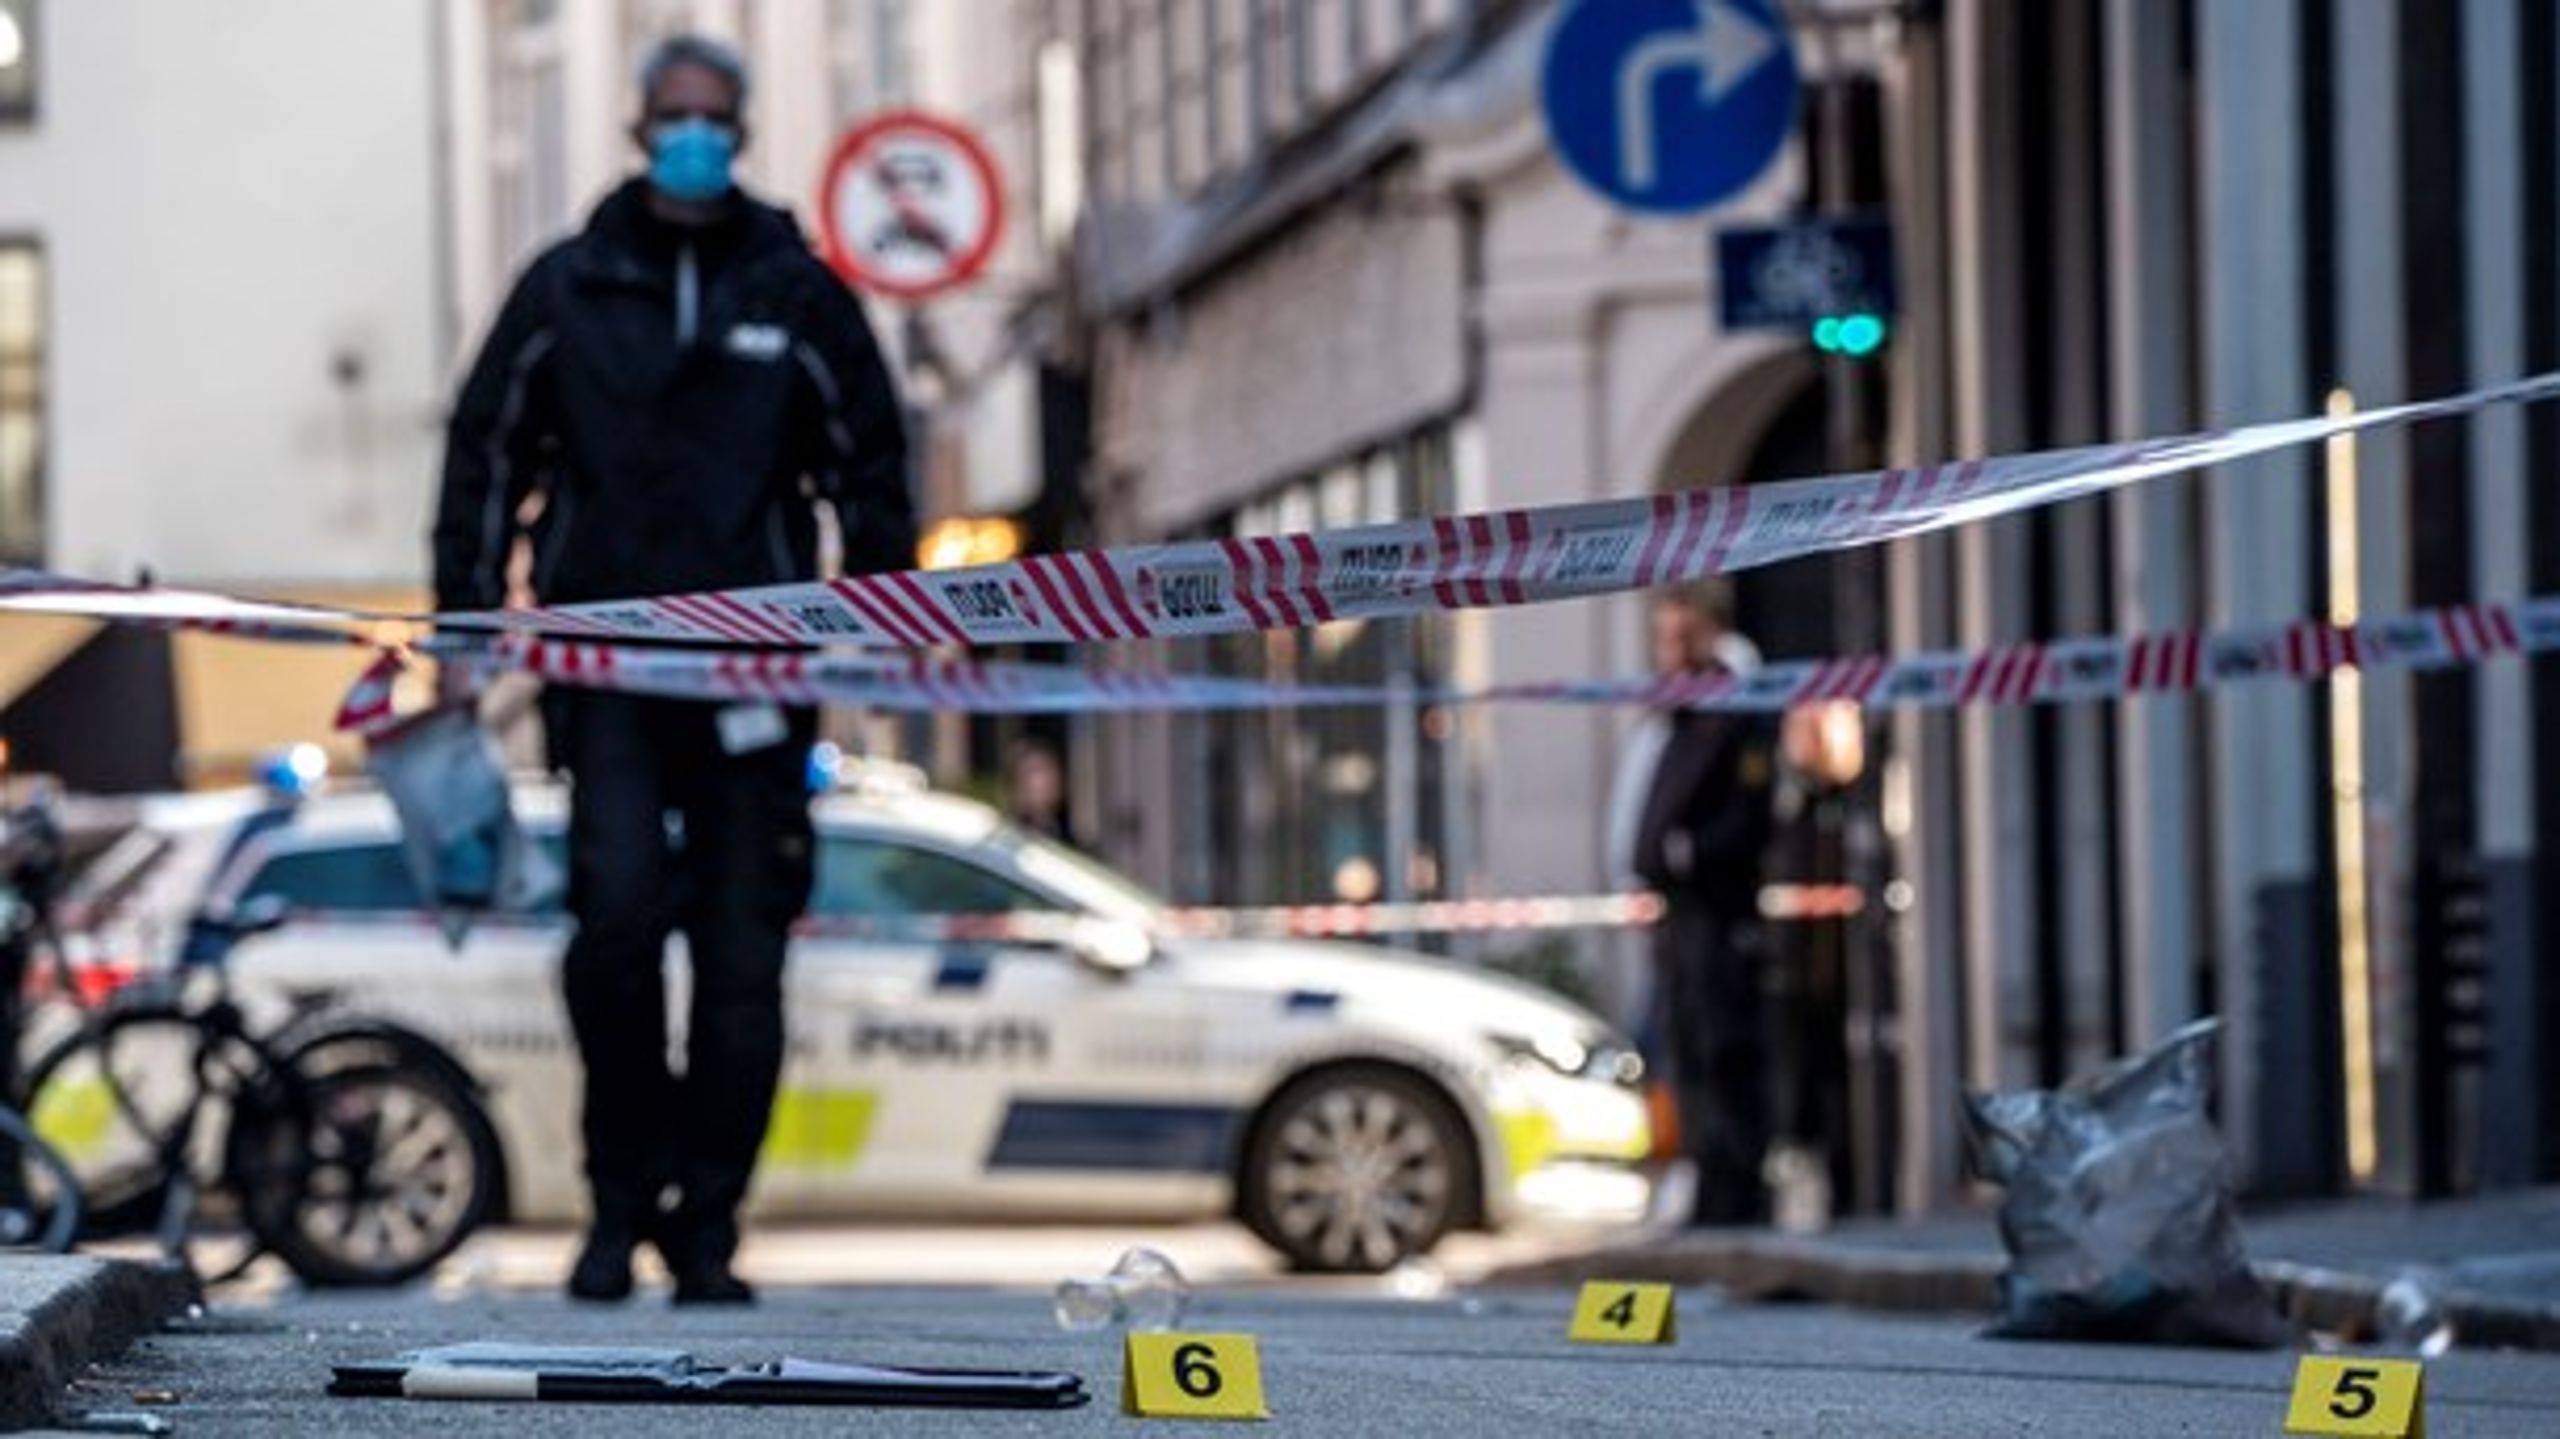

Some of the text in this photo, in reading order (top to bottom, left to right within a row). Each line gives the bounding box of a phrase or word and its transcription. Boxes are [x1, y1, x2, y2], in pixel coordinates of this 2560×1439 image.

[852, 1022, 1053, 1064] POLITI
[1601, 1291, 1636, 1329] 4
[1174, 1342, 1222, 1398] 6
[2329, 1368, 2379, 1419] 5
